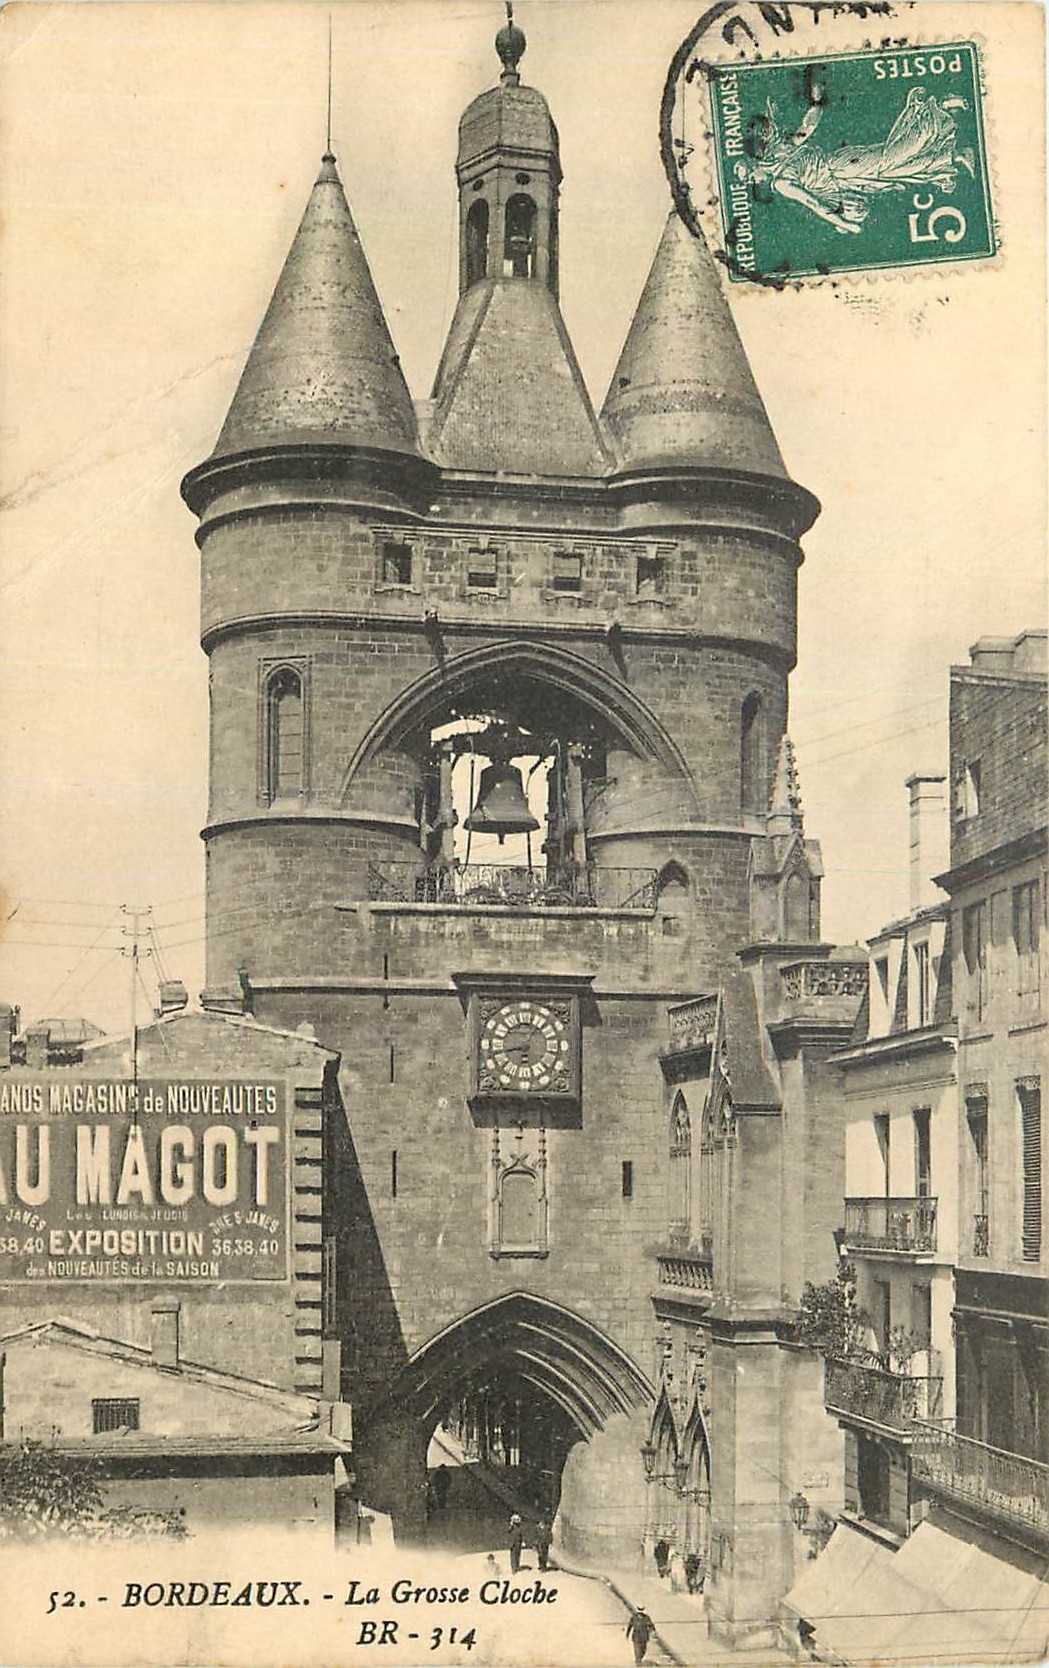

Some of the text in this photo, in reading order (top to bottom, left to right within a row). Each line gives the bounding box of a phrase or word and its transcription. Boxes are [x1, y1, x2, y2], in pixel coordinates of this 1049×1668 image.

[874, 53, 962, 79] POSTES
[144, 1087, 164, 1113] de
[0, 1124, 280, 1206] U MAGOT
[49, 1229, 204, 1256] EXPOSITION
[131, 1261, 150, 1276] de
[166, 1261, 219, 1277] SAISON
